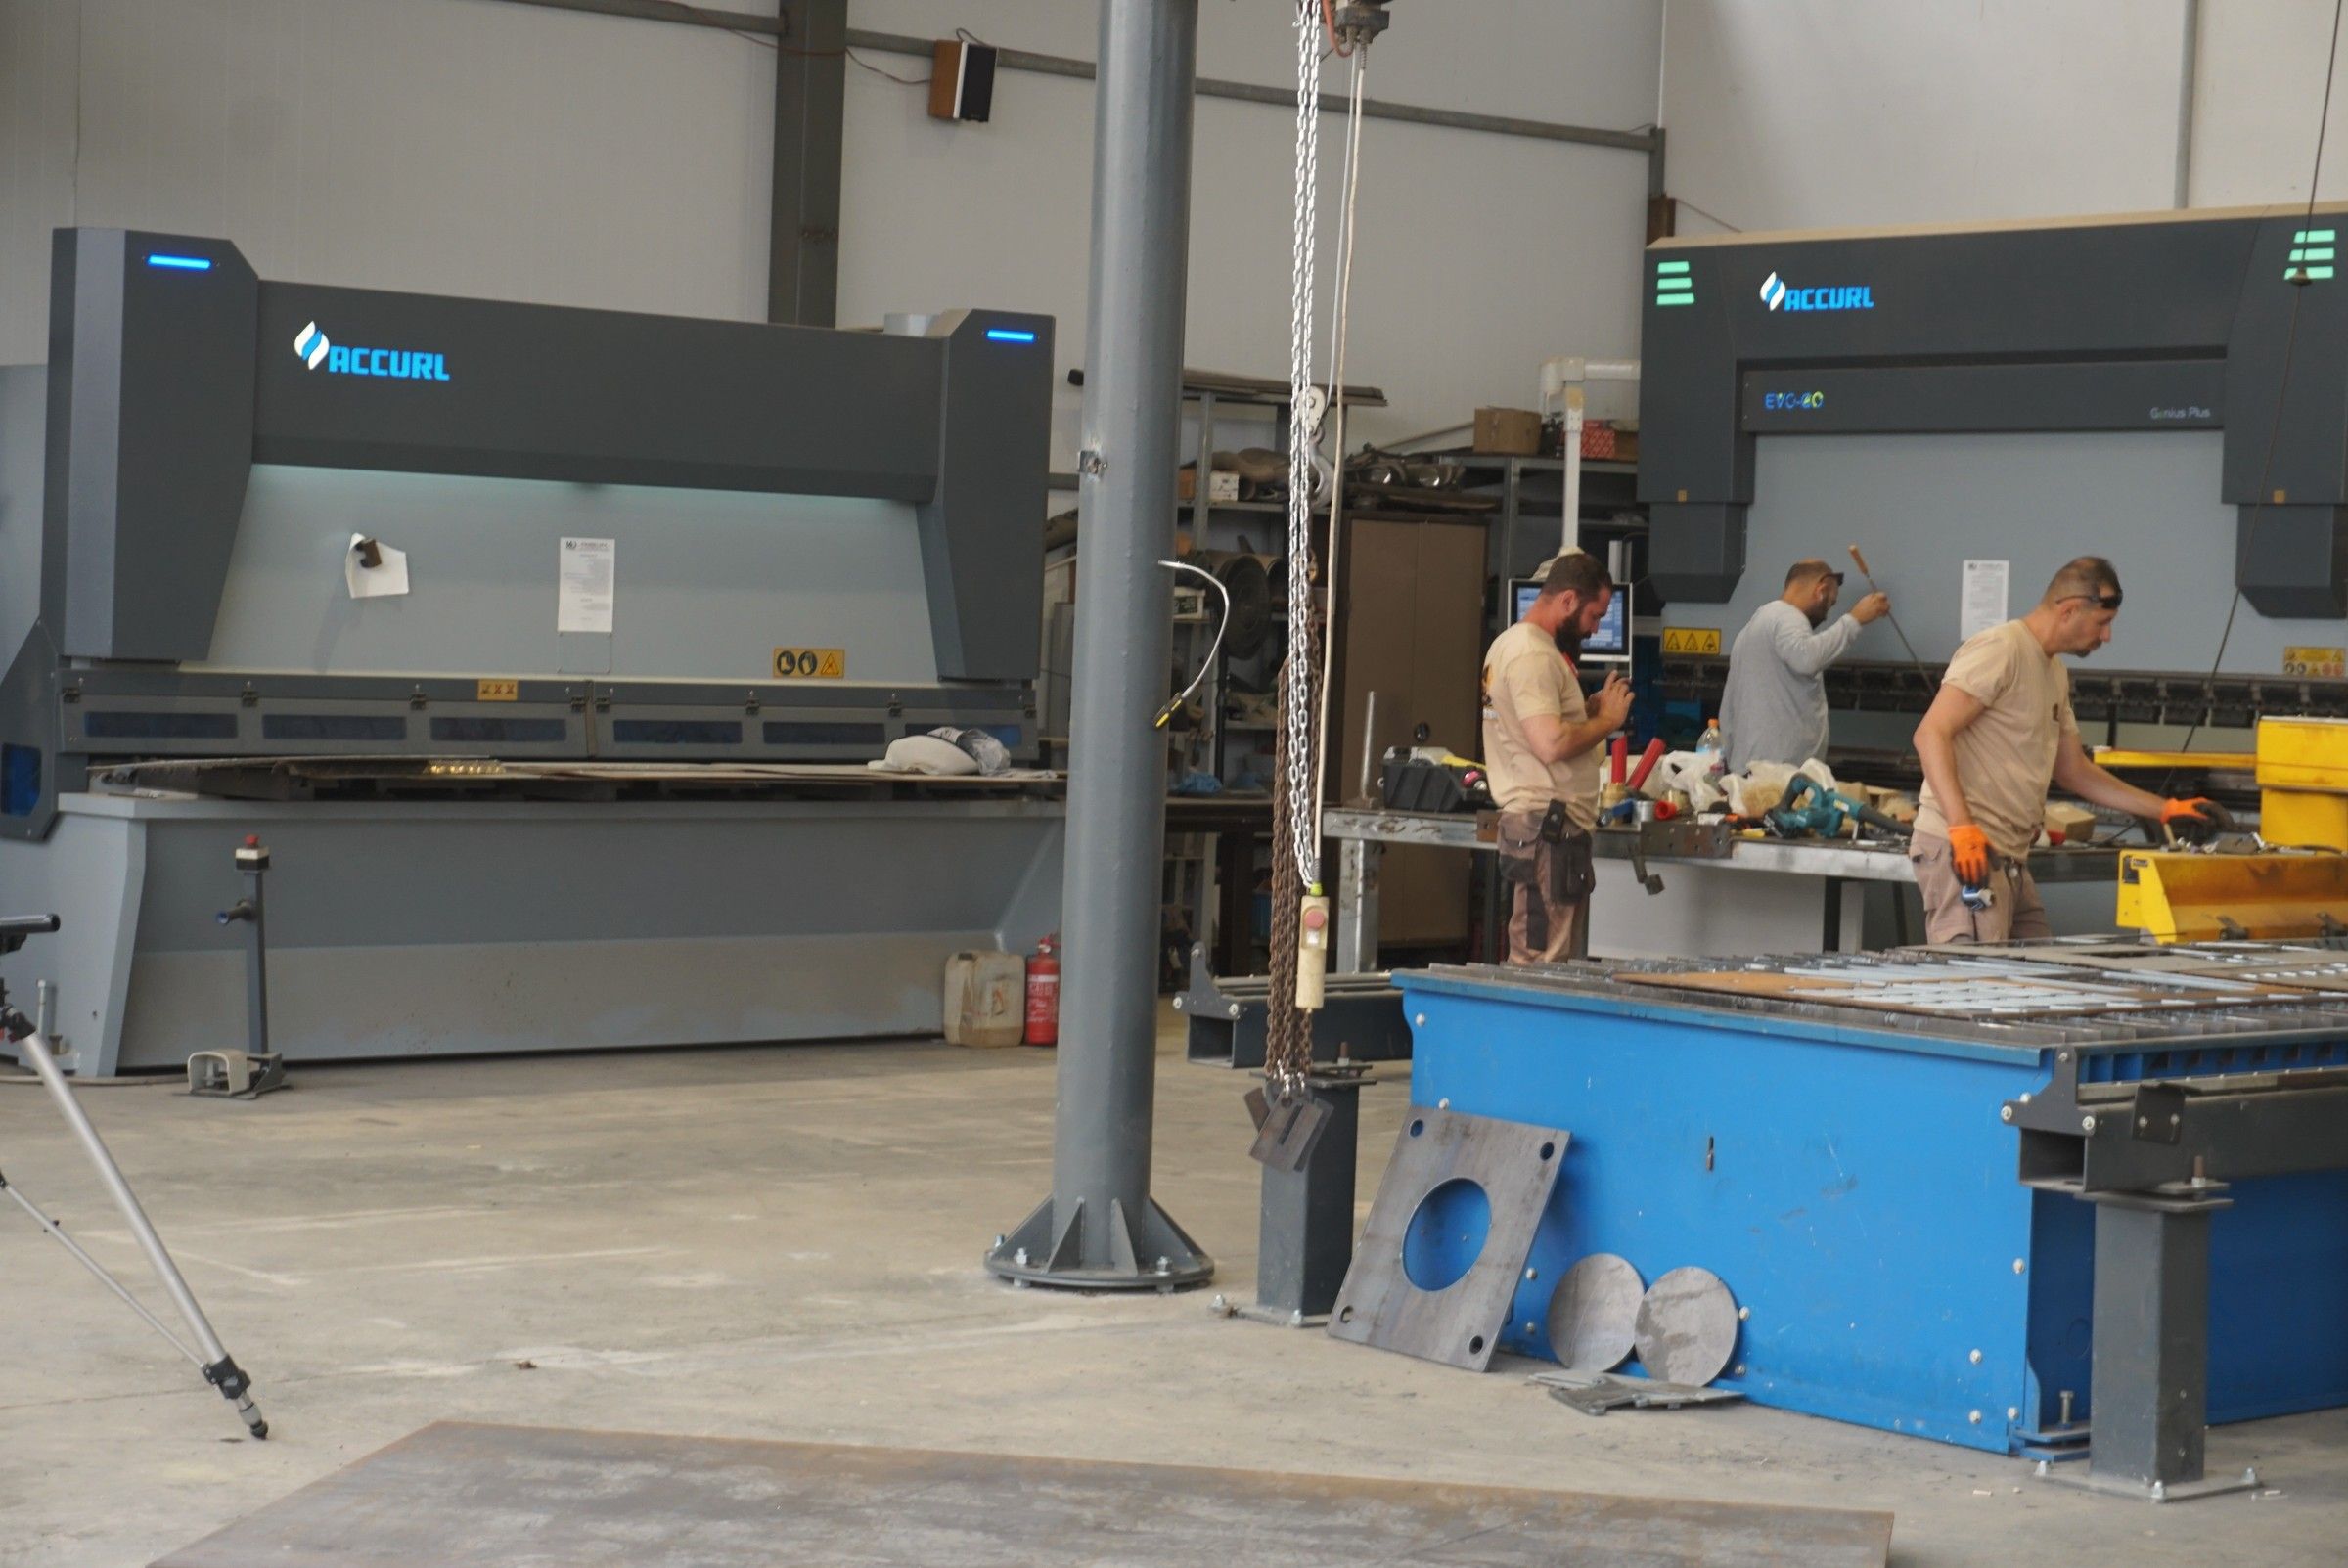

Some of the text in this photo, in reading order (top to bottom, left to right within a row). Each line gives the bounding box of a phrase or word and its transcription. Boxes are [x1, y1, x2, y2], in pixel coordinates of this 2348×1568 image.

[1784, 286, 1874, 311] ACCURL
[329, 345, 450, 381] ACCURL
[2189, 406, 2211, 419] Plus
